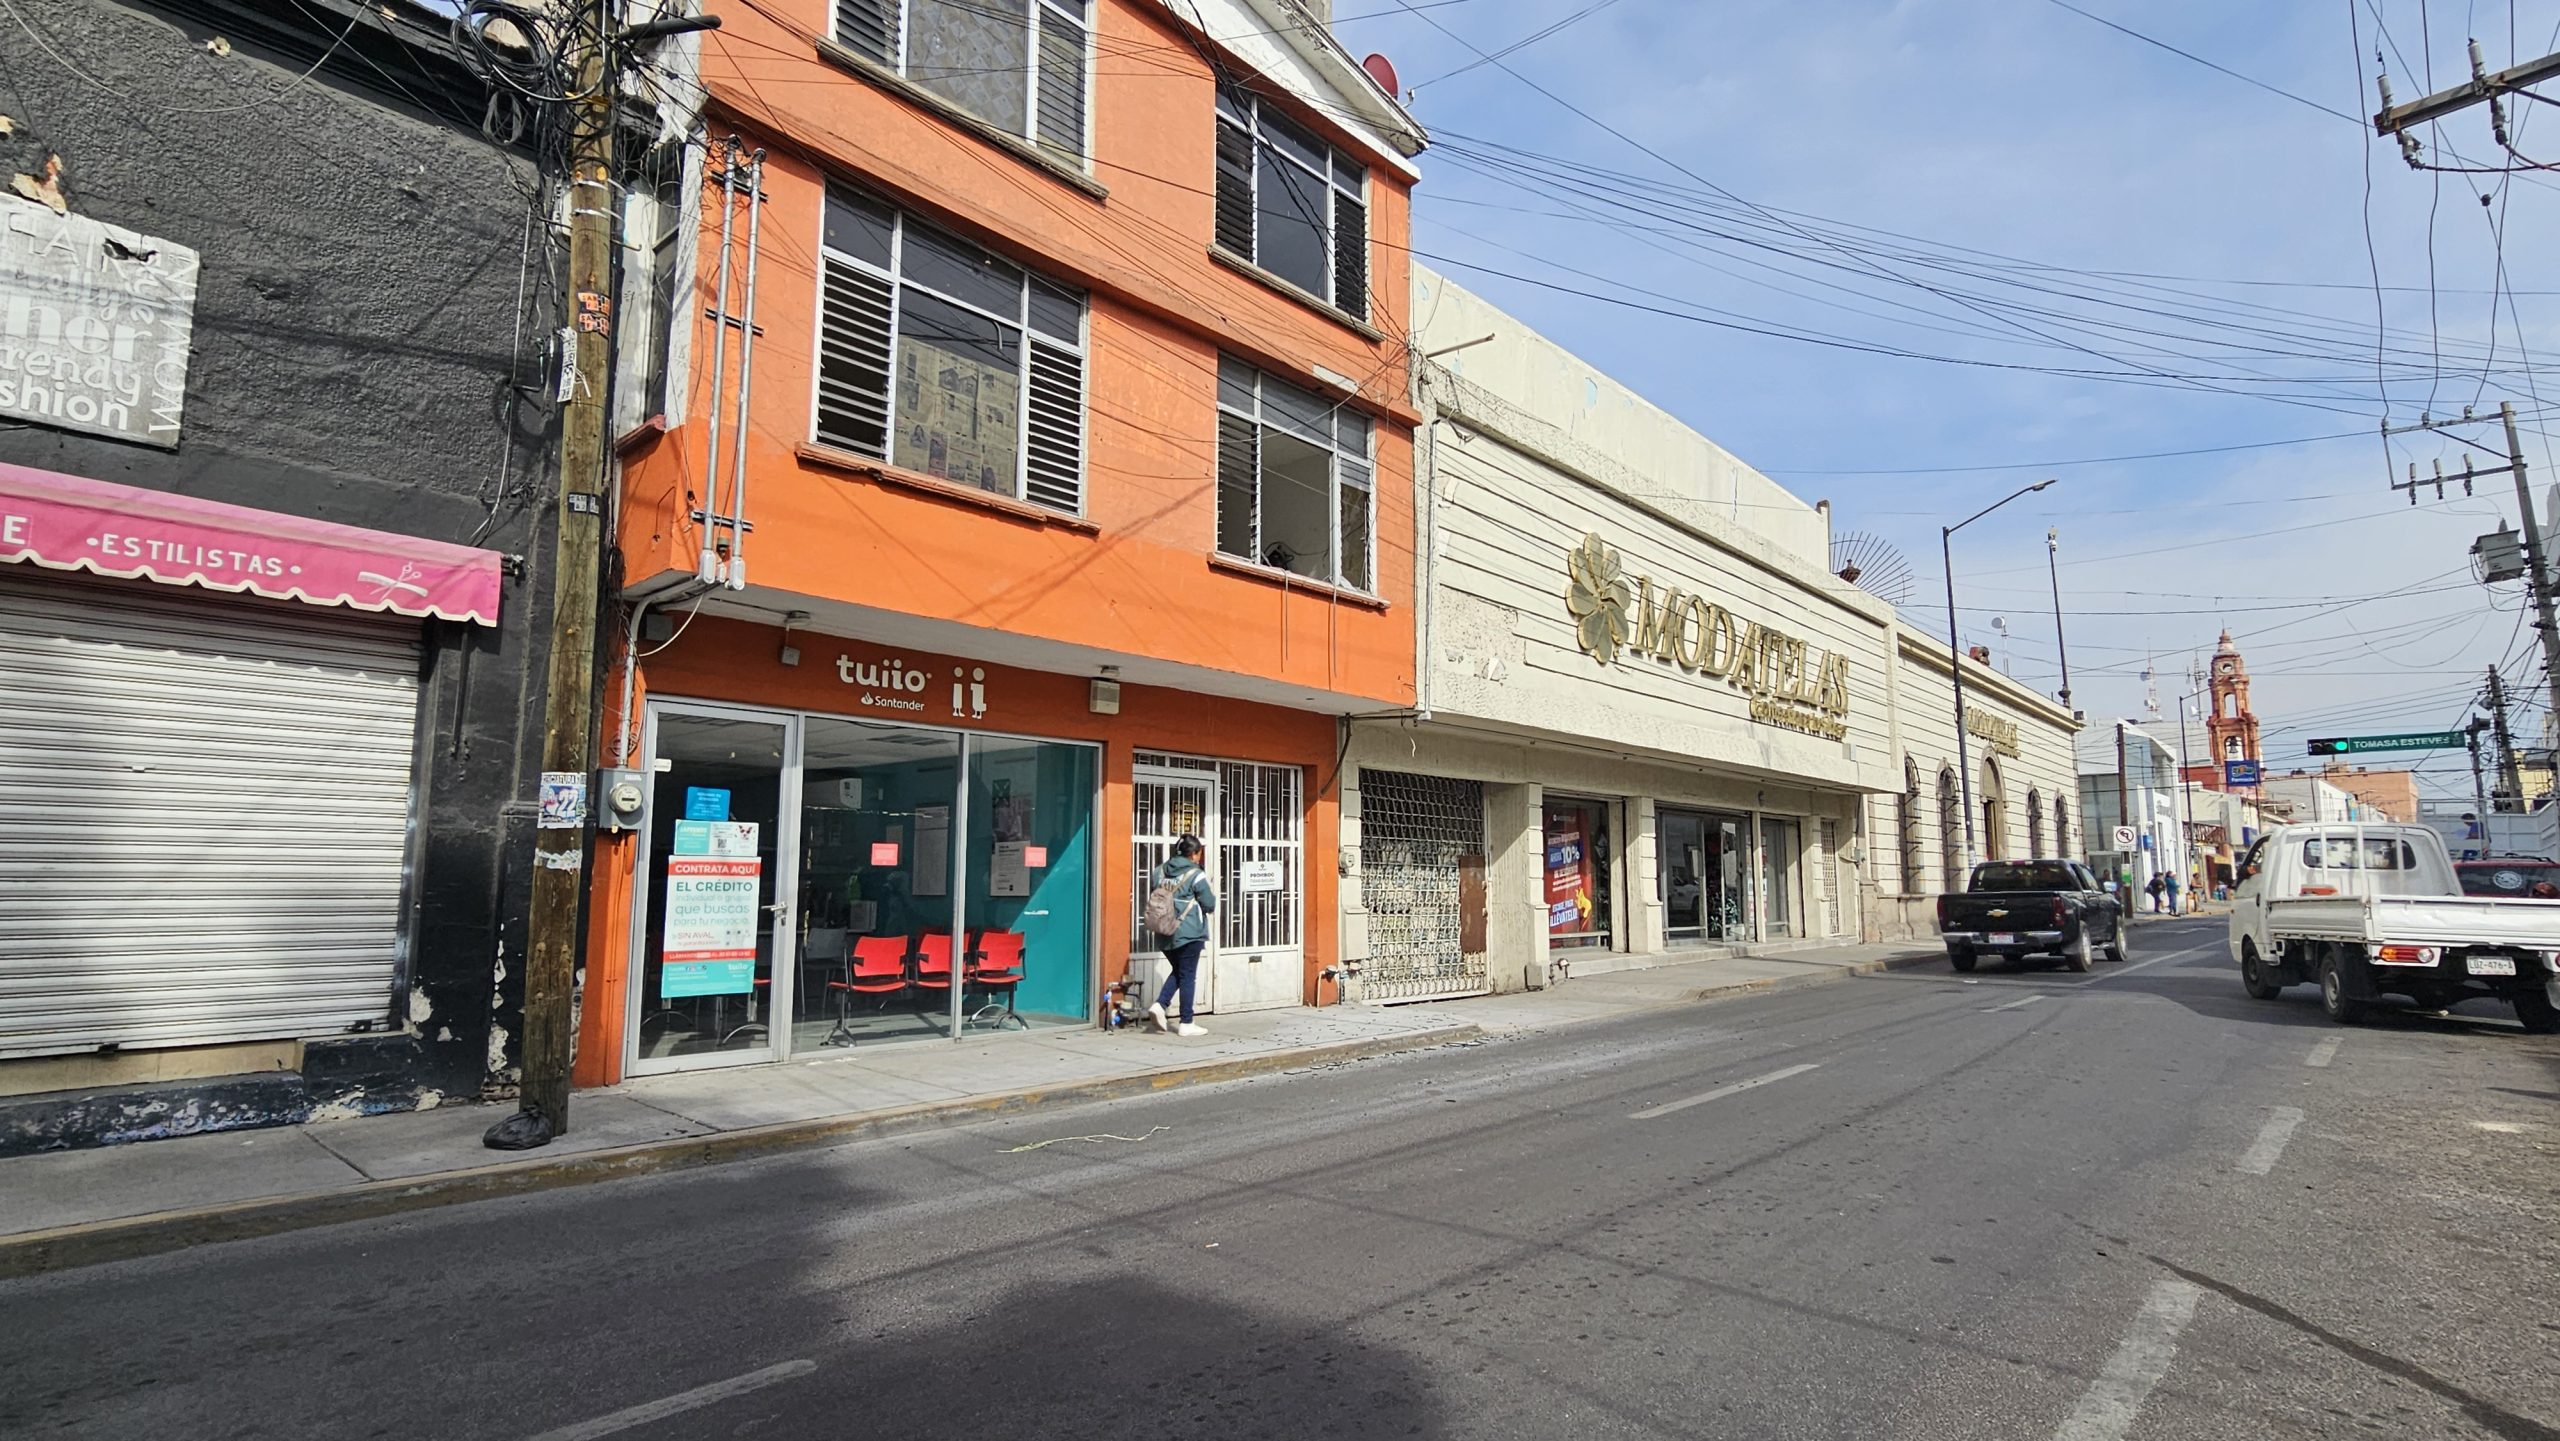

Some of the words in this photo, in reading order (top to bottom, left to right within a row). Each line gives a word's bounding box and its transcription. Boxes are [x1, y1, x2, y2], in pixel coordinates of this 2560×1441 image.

[101, 533, 283, 577] ESTILISTAS
[1630, 573, 1850, 719] MODATELAS
[836, 654, 926, 693] tuiio
[874, 695, 925, 711] Santander
[2353, 738, 2399, 749] TOMASA
[1561, 845, 1580, 864] 10%
[674, 864, 729, 874] CONTRATA
[731, 863, 756, 875] AQUÍ
[676, 881, 691, 892] EL
[695, 878, 753, 892] CRÉDITO
[674, 904, 701, 917] que
[703, 903, 751, 915] buscas
[673, 918, 697, 927] para
[699, 917, 709, 926] tu
